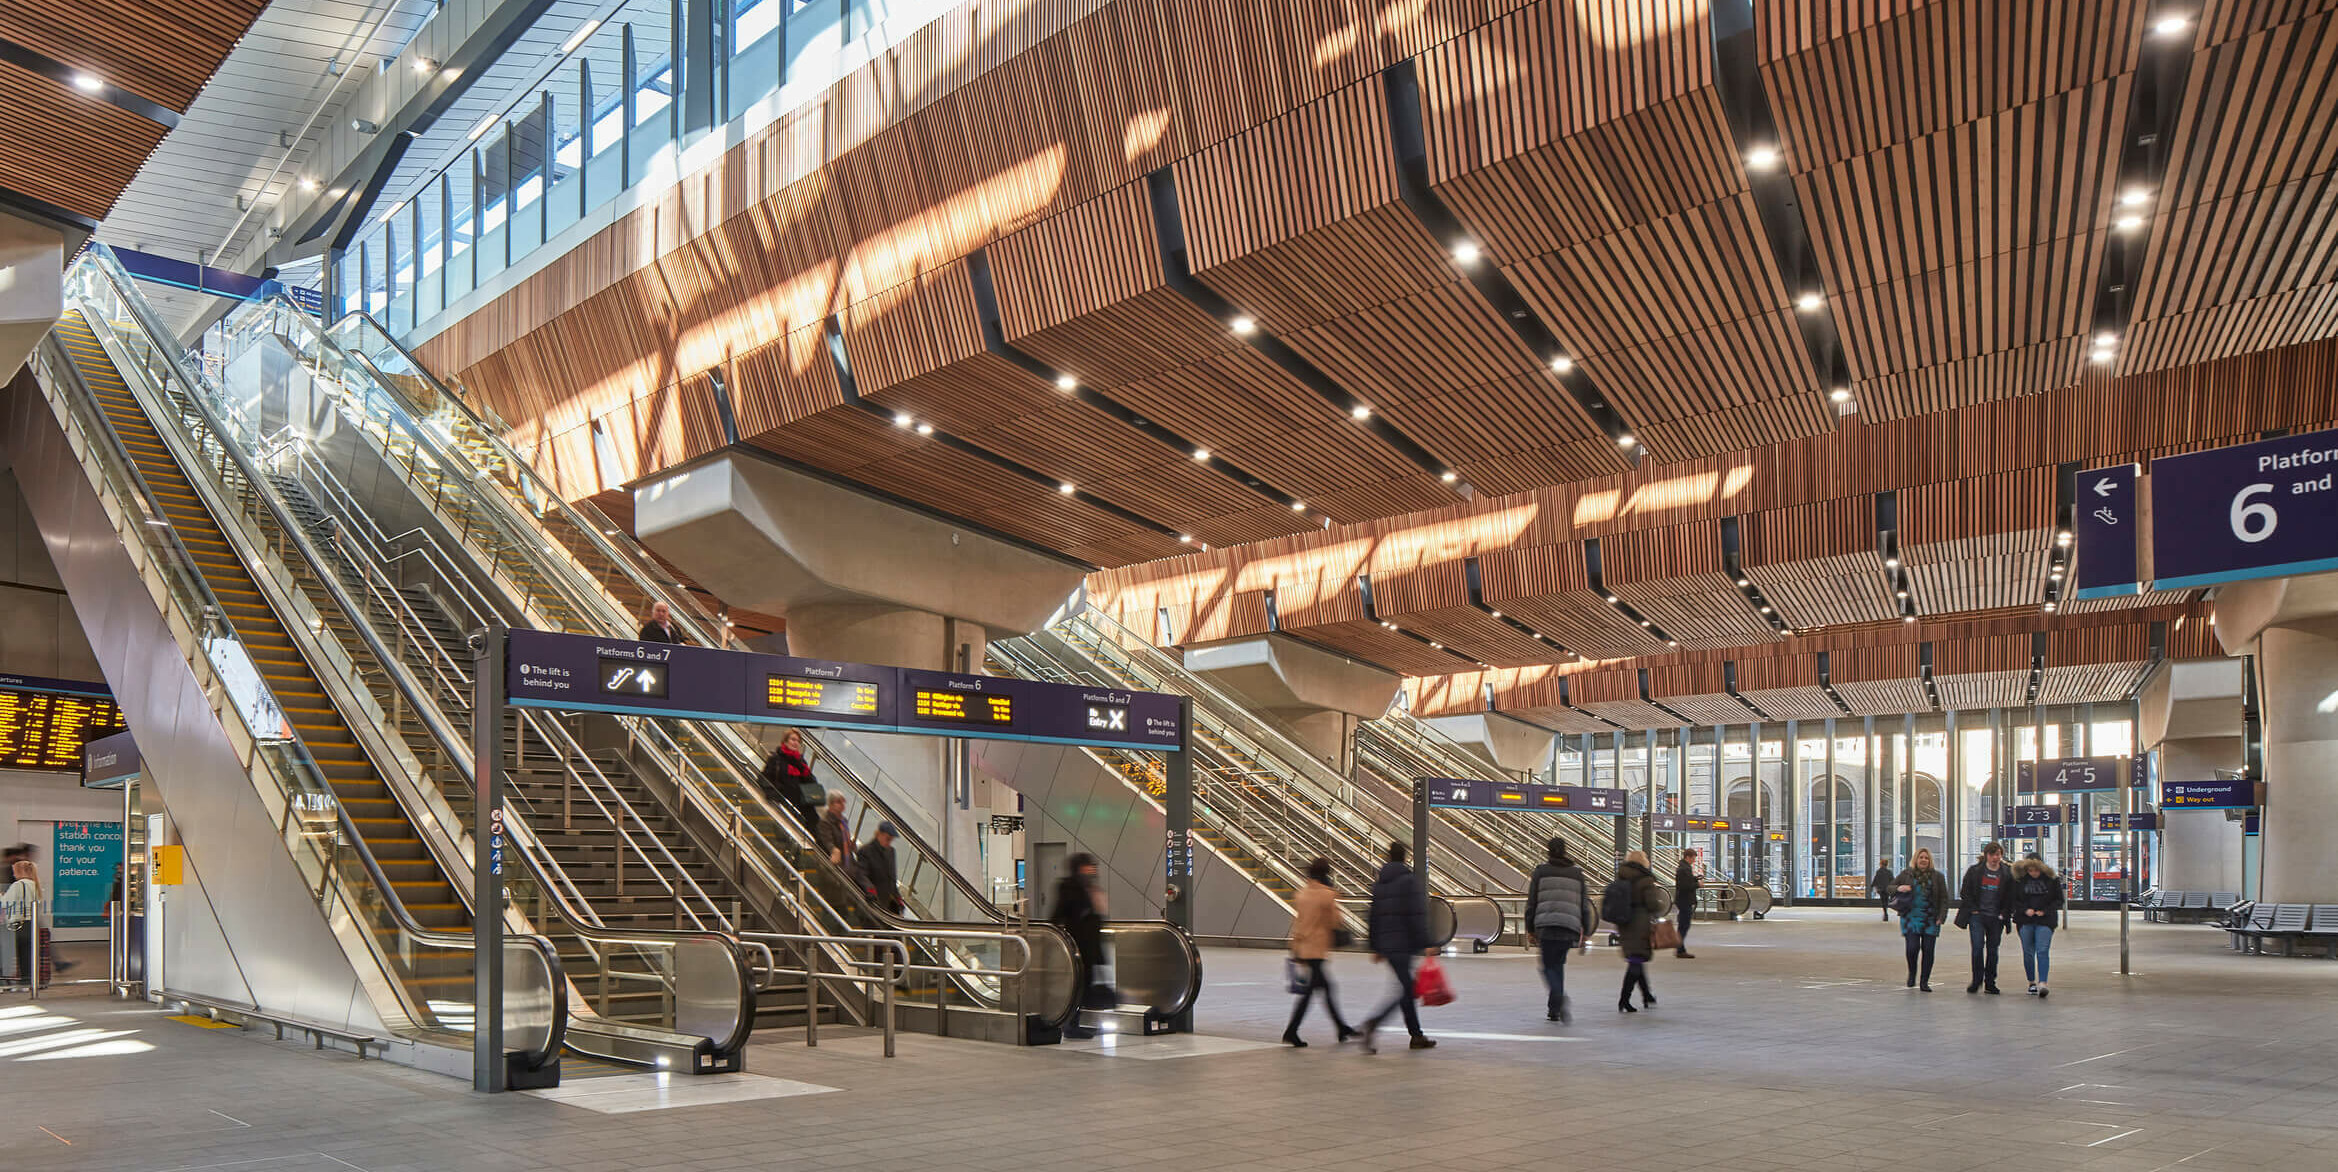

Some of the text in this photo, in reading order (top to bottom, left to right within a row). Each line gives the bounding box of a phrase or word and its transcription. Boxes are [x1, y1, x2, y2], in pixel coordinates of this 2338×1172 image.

[2230, 473, 2332, 543] 6 and
[596, 646, 671, 661] Platforms 6 and 7
[531, 665, 570, 677] The lift is
[805, 666, 842, 677] Platform 7
[523, 677, 570, 690] behind you
[948, 679, 982, 691] Platform 6
[1083, 692, 1131, 704] Platforms 6 and 7
[1089, 717, 1108, 728] Entry
[1162, 719, 1170, 727] lift
[1148, 728, 1165, 736] behind
[2055, 769, 2069, 785] 4
[2084, 767, 2096, 783] 5
[2186, 785, 2232, 794] Underground
[2026, 810, 2050, 821] 2 3
[59, 831, 91, 840] station
[2018, 828, 2025, 836] 1
[59, 842, 105, 854] thank you
[59, 854, 97, 865] for your
[58, 867, 99, 877] patience.
